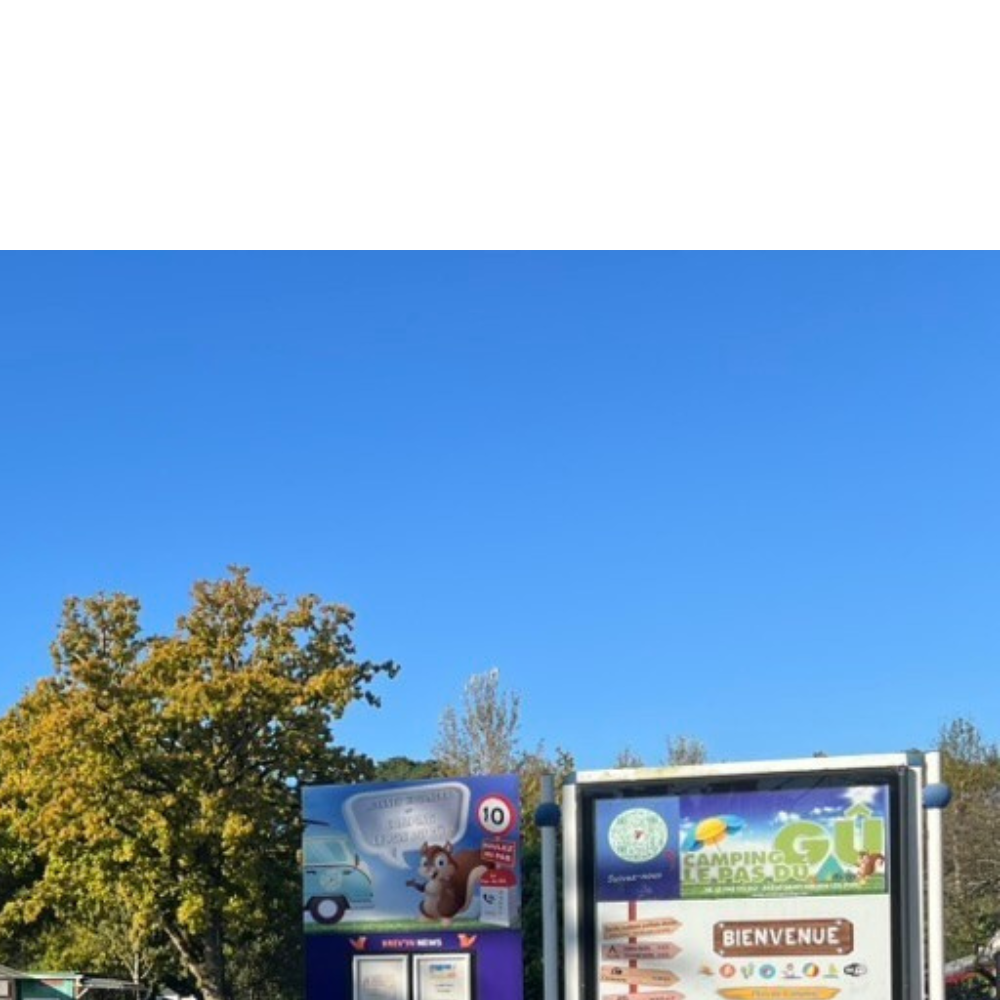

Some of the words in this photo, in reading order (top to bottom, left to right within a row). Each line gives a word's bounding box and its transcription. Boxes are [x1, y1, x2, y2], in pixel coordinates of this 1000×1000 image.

[483, 806, 505, 825] 10
[683, 850, 788, 868] CAMPING
[683, 867, 712, 884] LE
[718, 866, 765, 883] PAS
[773, 864, 809, 882] DU
[417, 938, 442, 948] NEWS
[722, 926, 840, 948] BIENVENUE
